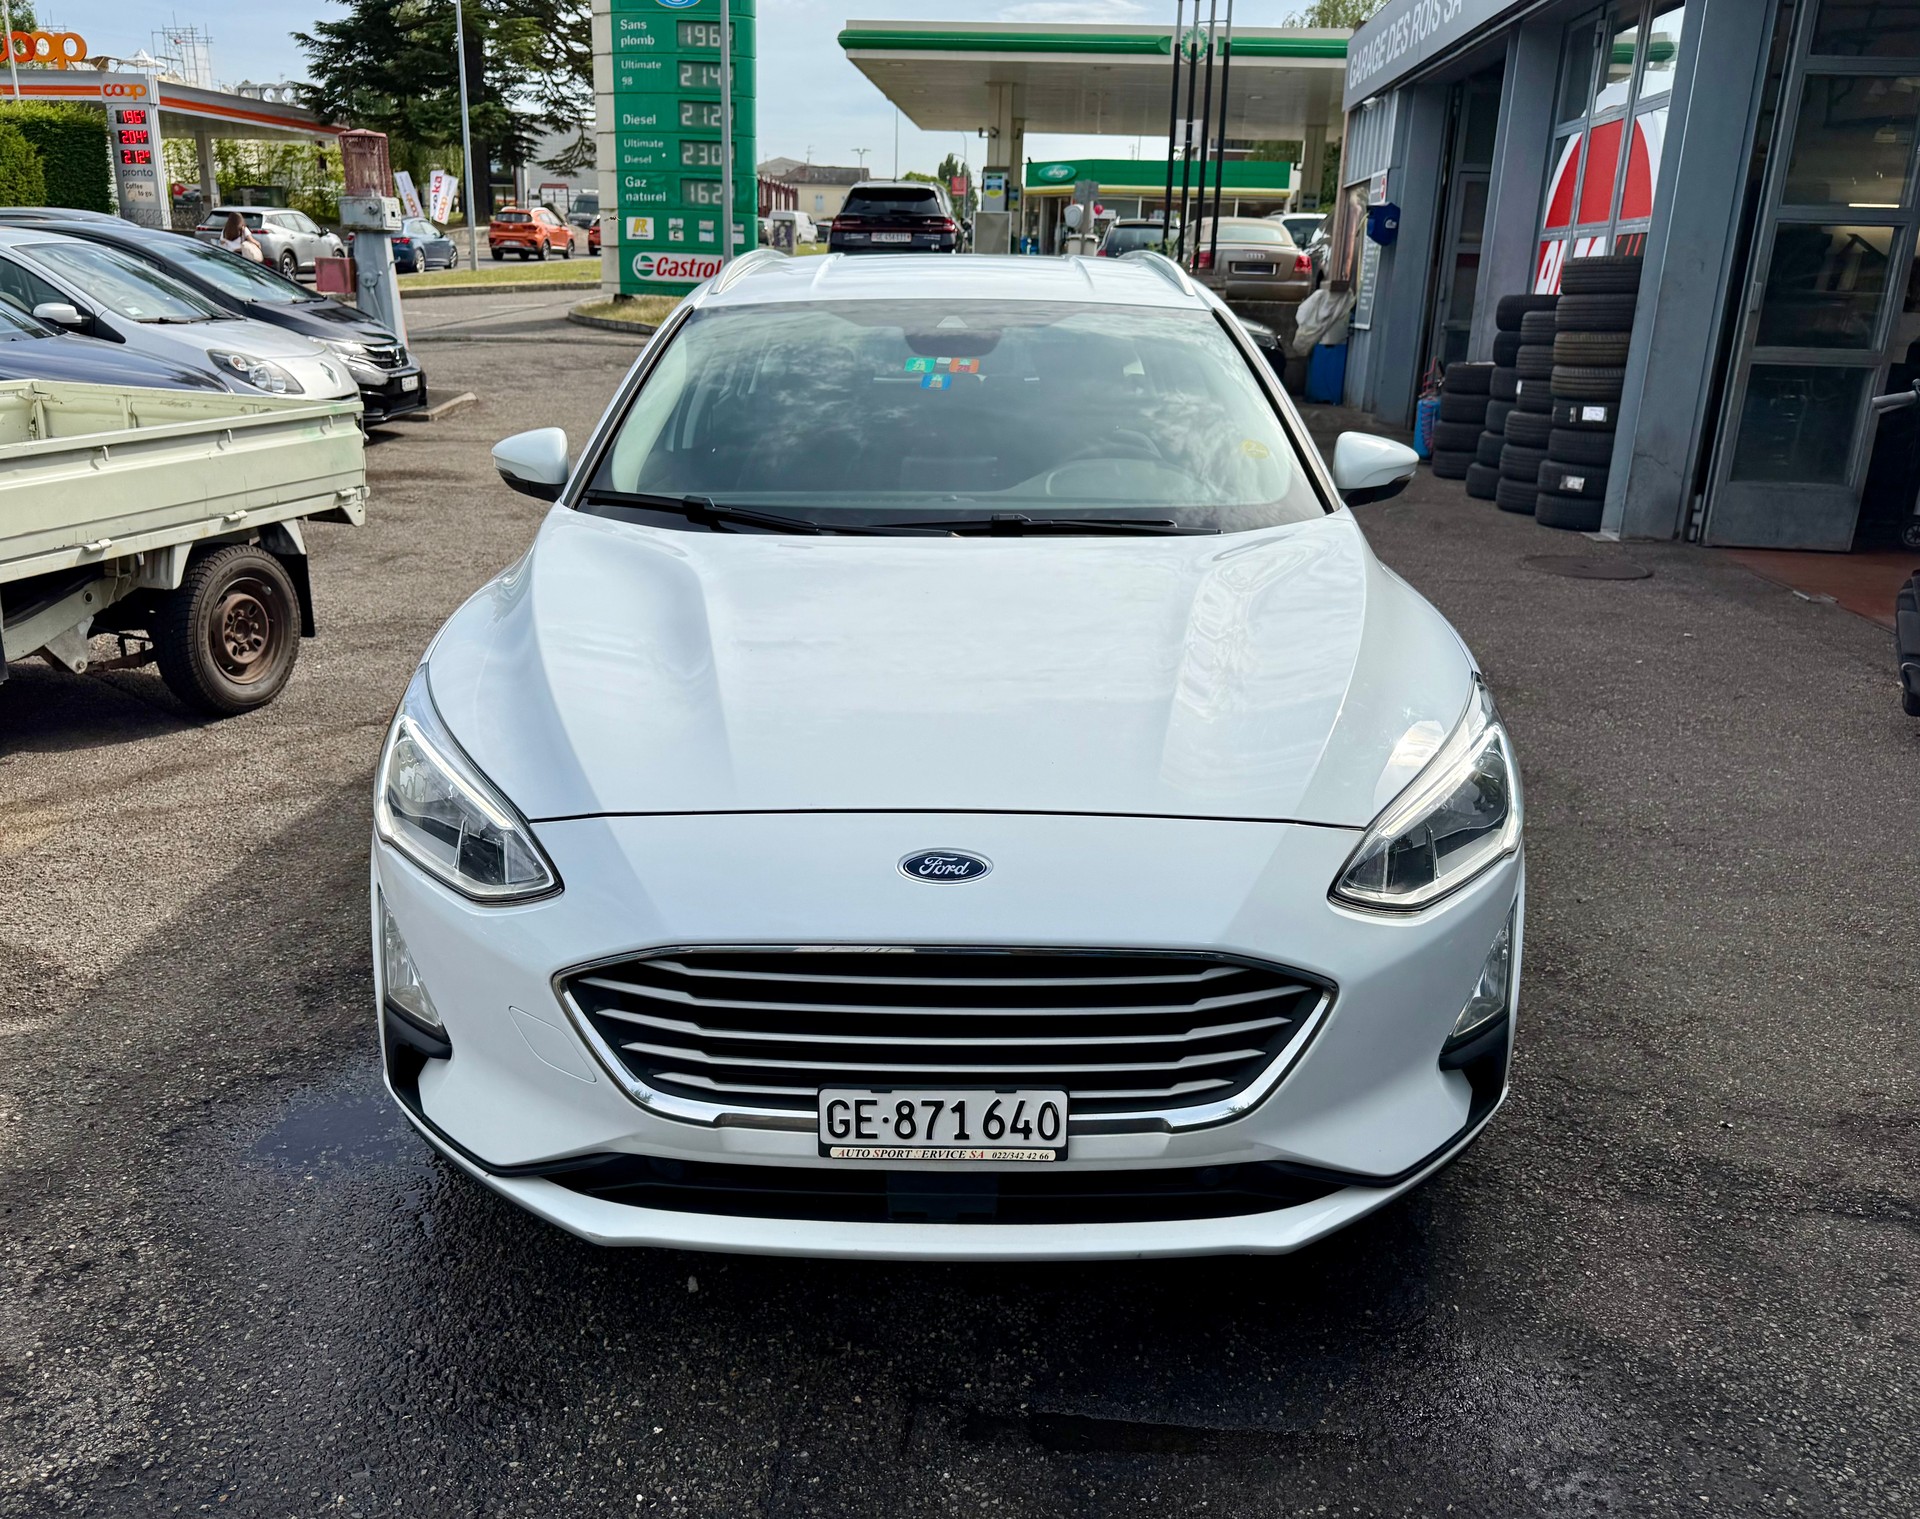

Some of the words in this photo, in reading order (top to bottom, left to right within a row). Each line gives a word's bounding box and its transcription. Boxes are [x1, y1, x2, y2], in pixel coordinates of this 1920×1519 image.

[620, 19, 647, 30] Sans
[621, 34, 655, 48] plomb
[1349, 29, 1388, 90] GARAGE
[1386, 11, 1411, 64] DES
[1410, 0, 1441, 48] ROIS
[621, 60, 662, 69] Ultimate
[622, 76, 633, 86] 98
[103, 83, 147, 100] coop
[623, 114, 657, 125] Diesel
[624, 139, 664, 149] Ultimate
[624, 155, 652, 164] Diesel
[122, 168, 154, 177] pronto
[625, 176, 647, 188] Gaz
[626, 191, 667, 202] naturel
[437, 196, 448, 220] coop
[656, 257, 723, 279] Castrol
[919, 857, 971, 875] Ford
[837, 1149, 871, 1159] AUTO
[872, 1149, 913, 1160] SPORT
[968, 1150, 985, 1160] SA
[991, 1151, 1025, 1161] 022/342
[1026, 1152, 1038, 1161] 42
[1039, 1153, 1050, 1161] 66
